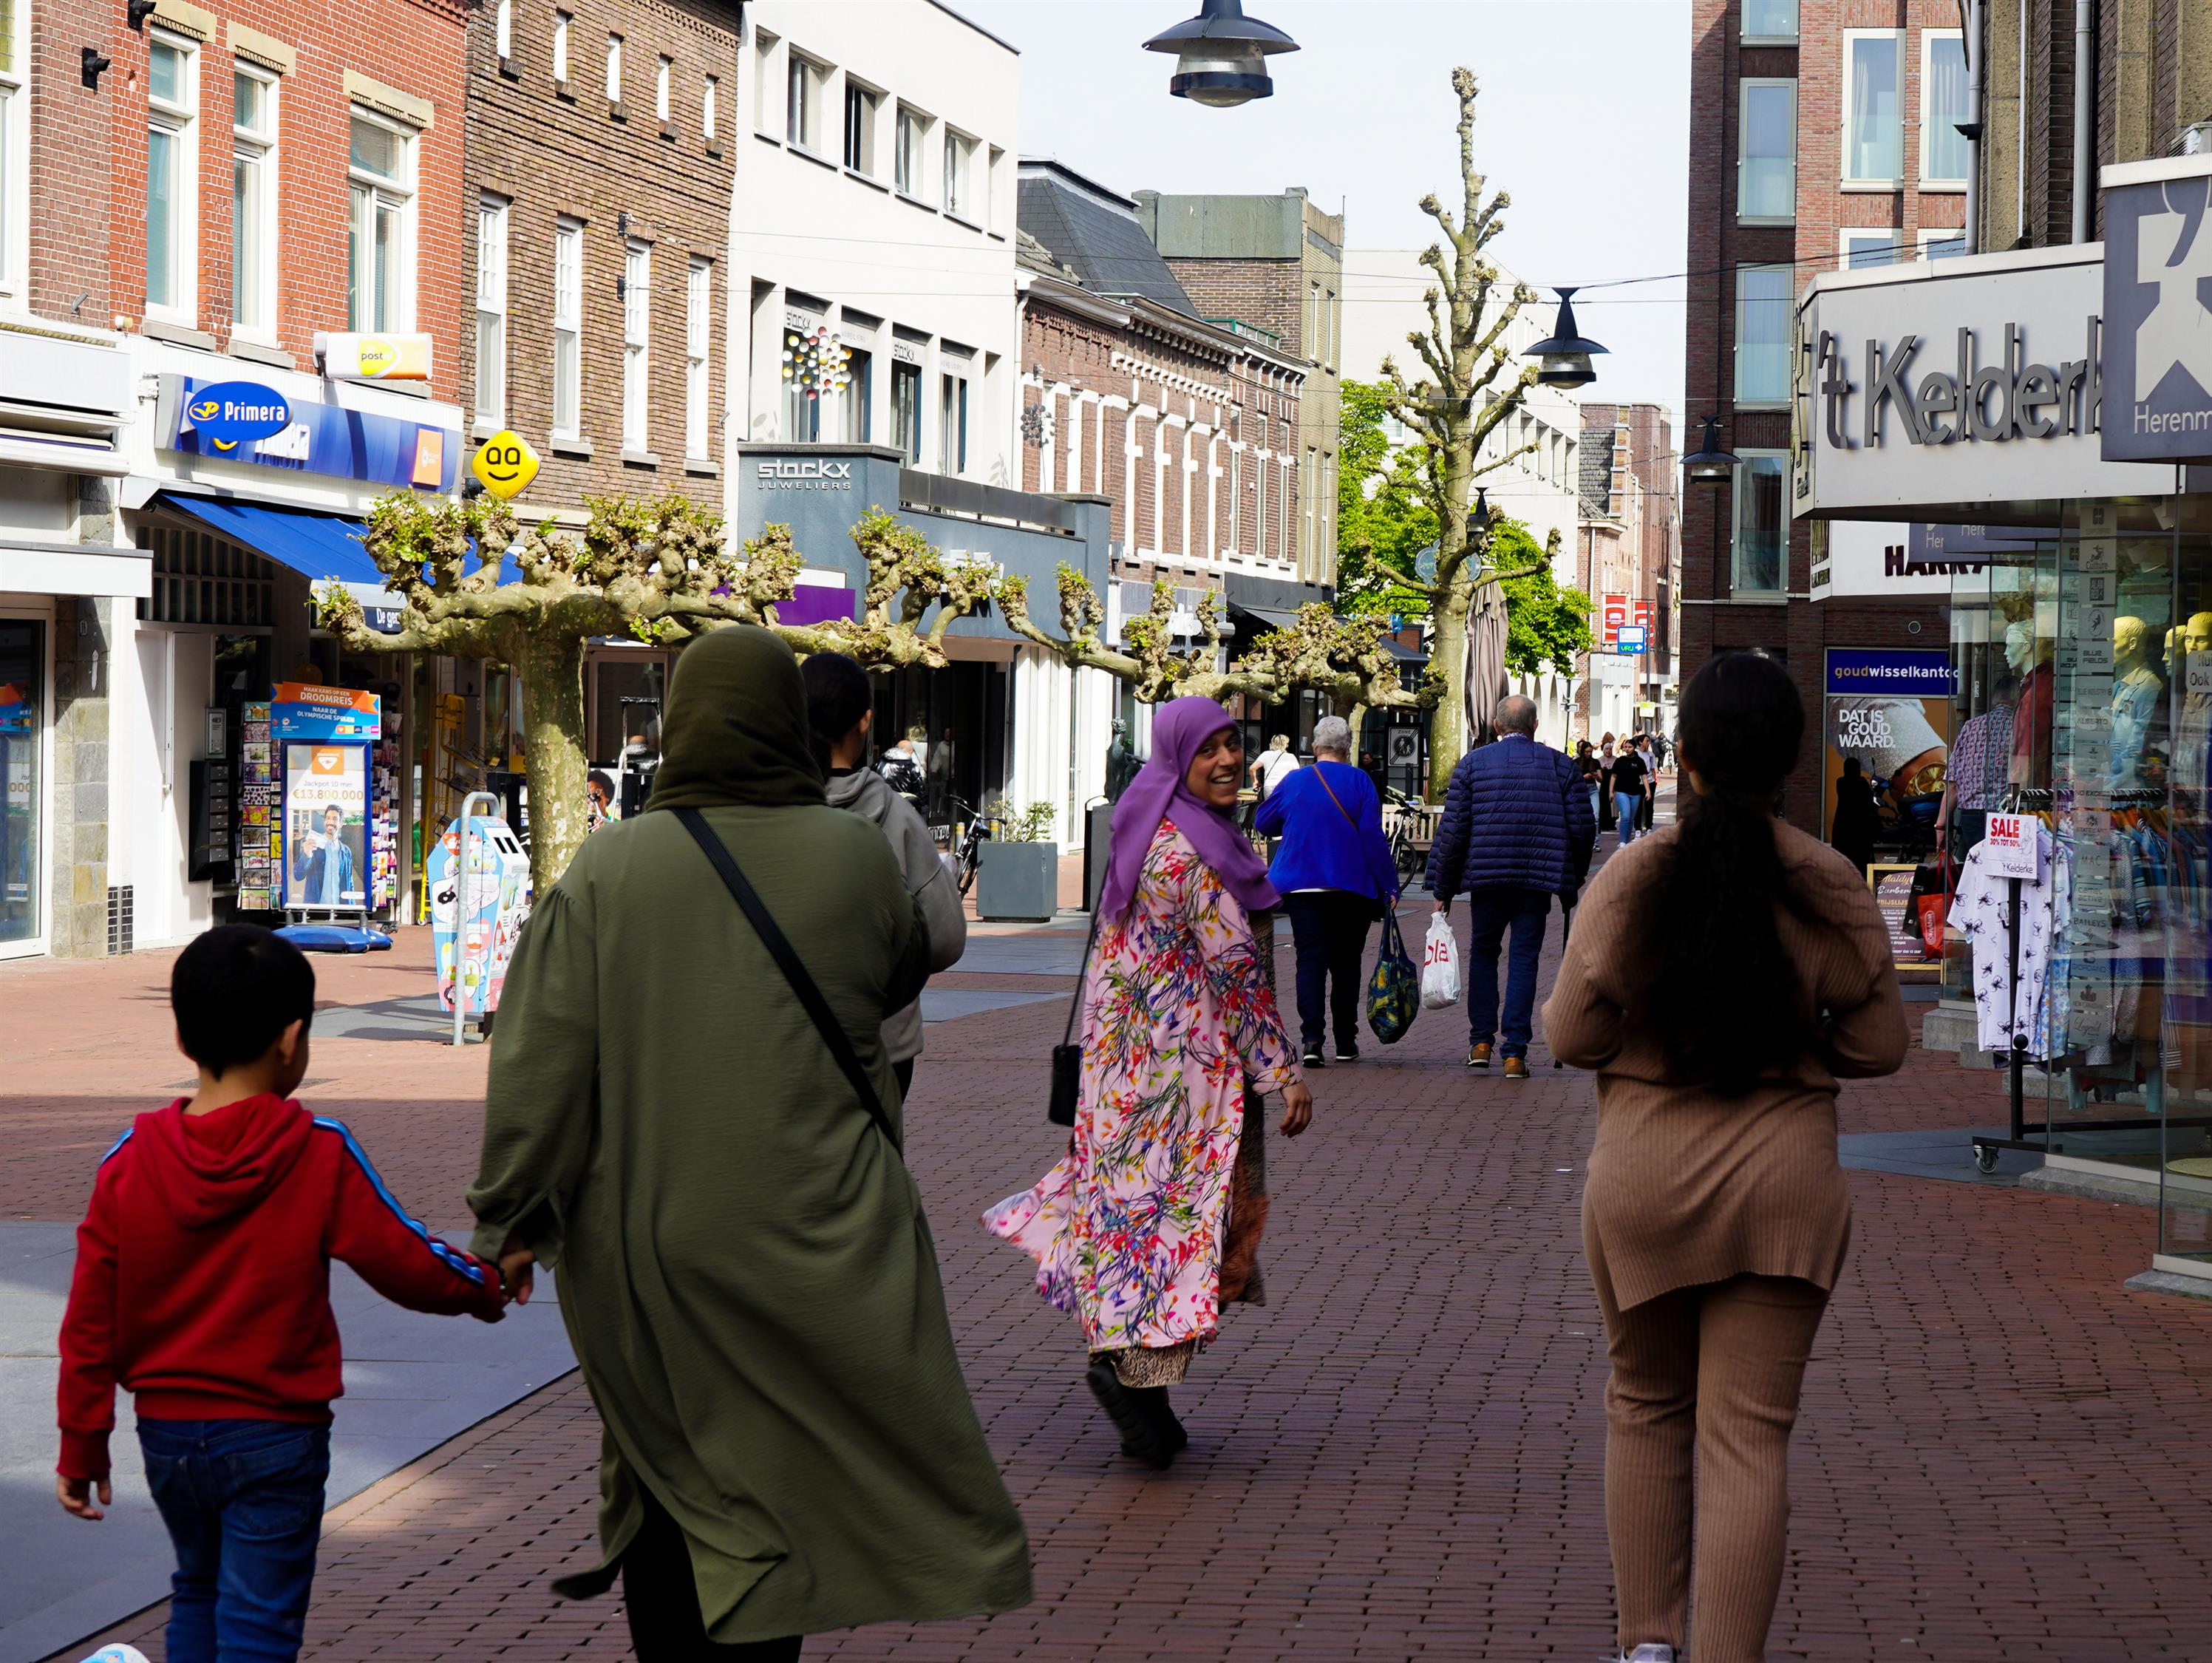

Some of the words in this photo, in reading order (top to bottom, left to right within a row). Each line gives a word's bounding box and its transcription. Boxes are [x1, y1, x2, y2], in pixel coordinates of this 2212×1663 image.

[225, 401, 285, 421] Primera
[758, 482, 851, 490] JUWELIERS
[376, 608, 386, 625] De
[300, 692, 353, 706] DROOMREIS
[297, 711, 333, 721] OLYMPISCHE
[333, 715, 355, 723] SPELEN
[1839, 710, 1868, 723] DAT
[1871, 710, 1884, 722] IS
[1848, 722, 1891, 735] GOUD
[1839, 734, 1896, 748] WAARD.
[293, 789, 364, 800] €13.800.000
[1990, 817, 2020, 838] SALE
[2081, 855, 2103, 867] MAC
[2007, 863, 2033, 874] Kelderke
[2074, 917, 2106, 928] BAILEYS
